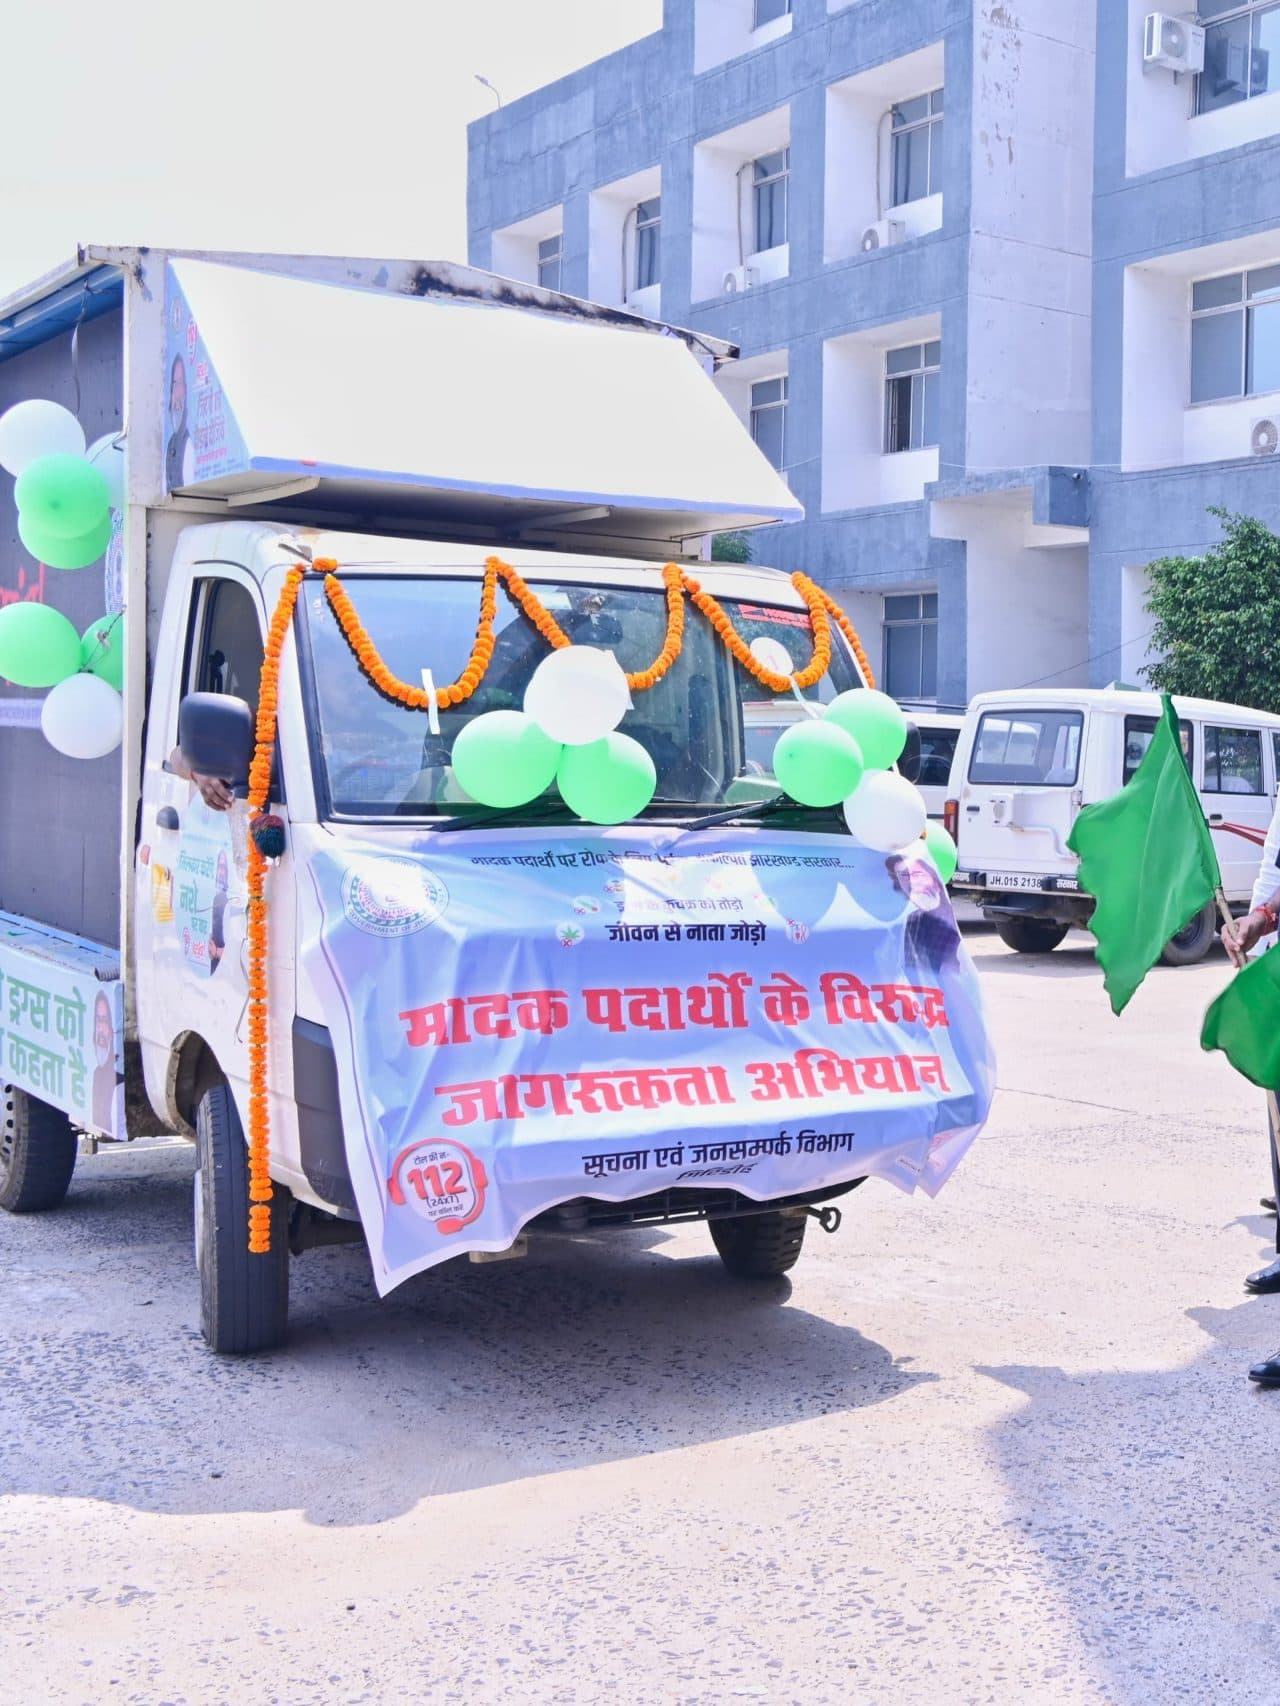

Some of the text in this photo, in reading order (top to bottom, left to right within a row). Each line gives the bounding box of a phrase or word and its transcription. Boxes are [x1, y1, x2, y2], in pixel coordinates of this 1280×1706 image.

[556, 853, 578, 867] पर
[605, 919, 767, 946] जीवन से नाता जोड़ो
[53, 985, 87, 1046] को
[399, 990, 569, 1047] मादक
[760, 972, 810, 1026] के
[7, 1031, 65, 1098] कहता
[68, 1045, 87, 1109] है
[745, 1047, 952, 1101] अभियान
[582, 1129, 855, 1178] सूचना एवं जनसम्पर्क विभाग
[407, 1161, 467, 1200] 112
